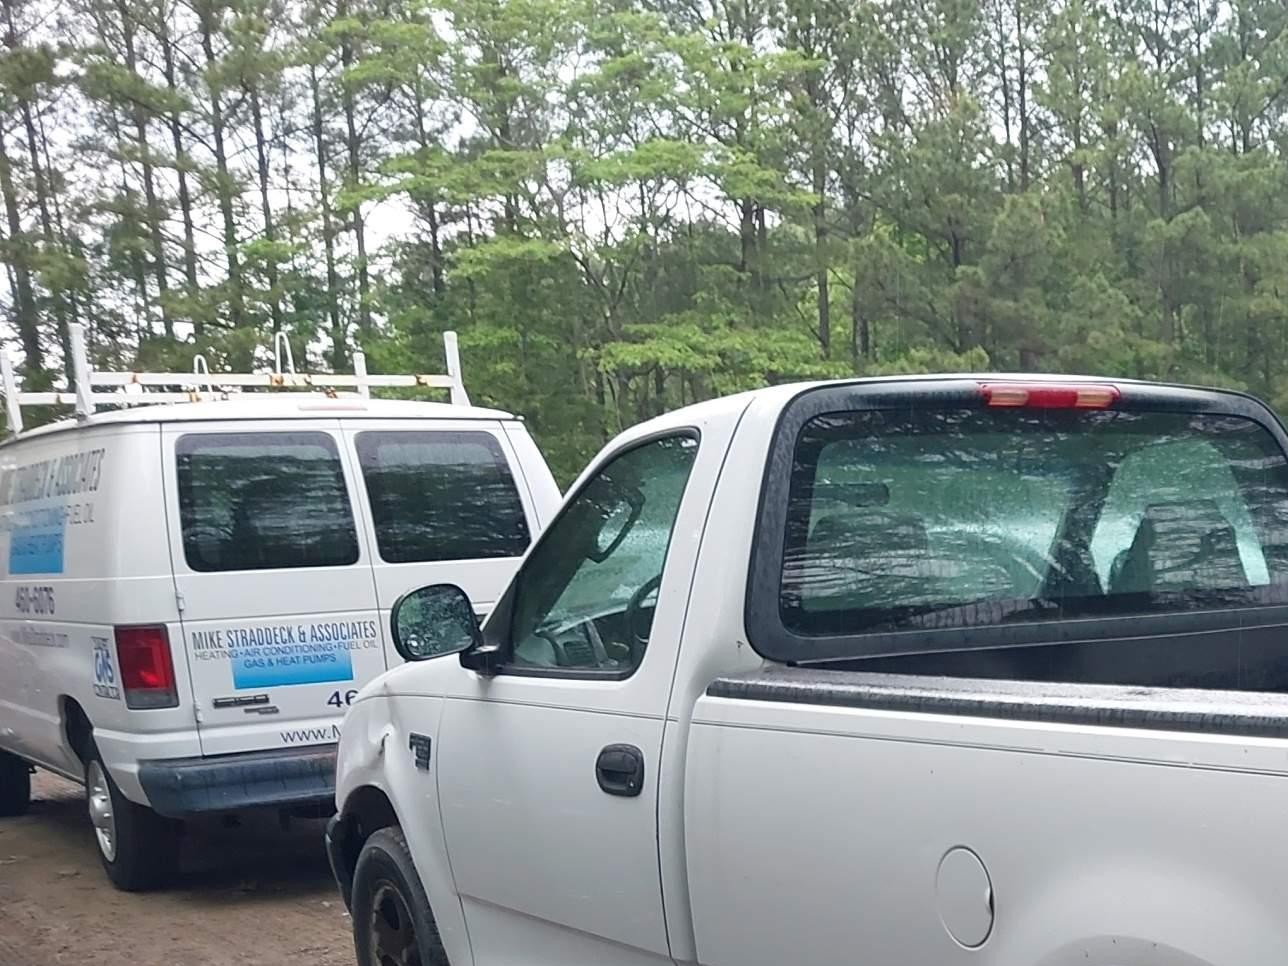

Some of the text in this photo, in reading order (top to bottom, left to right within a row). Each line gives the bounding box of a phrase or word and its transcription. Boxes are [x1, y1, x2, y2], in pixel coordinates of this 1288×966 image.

[192, 620, 377, 650] MIKE STRADDECK & ASSOCIATES
[263, 643, 333, 657] CONDITIONING
[363, 639, 378, 649] OIL
[243, 653, 337, 669] GAS & HEAT PUMPS
